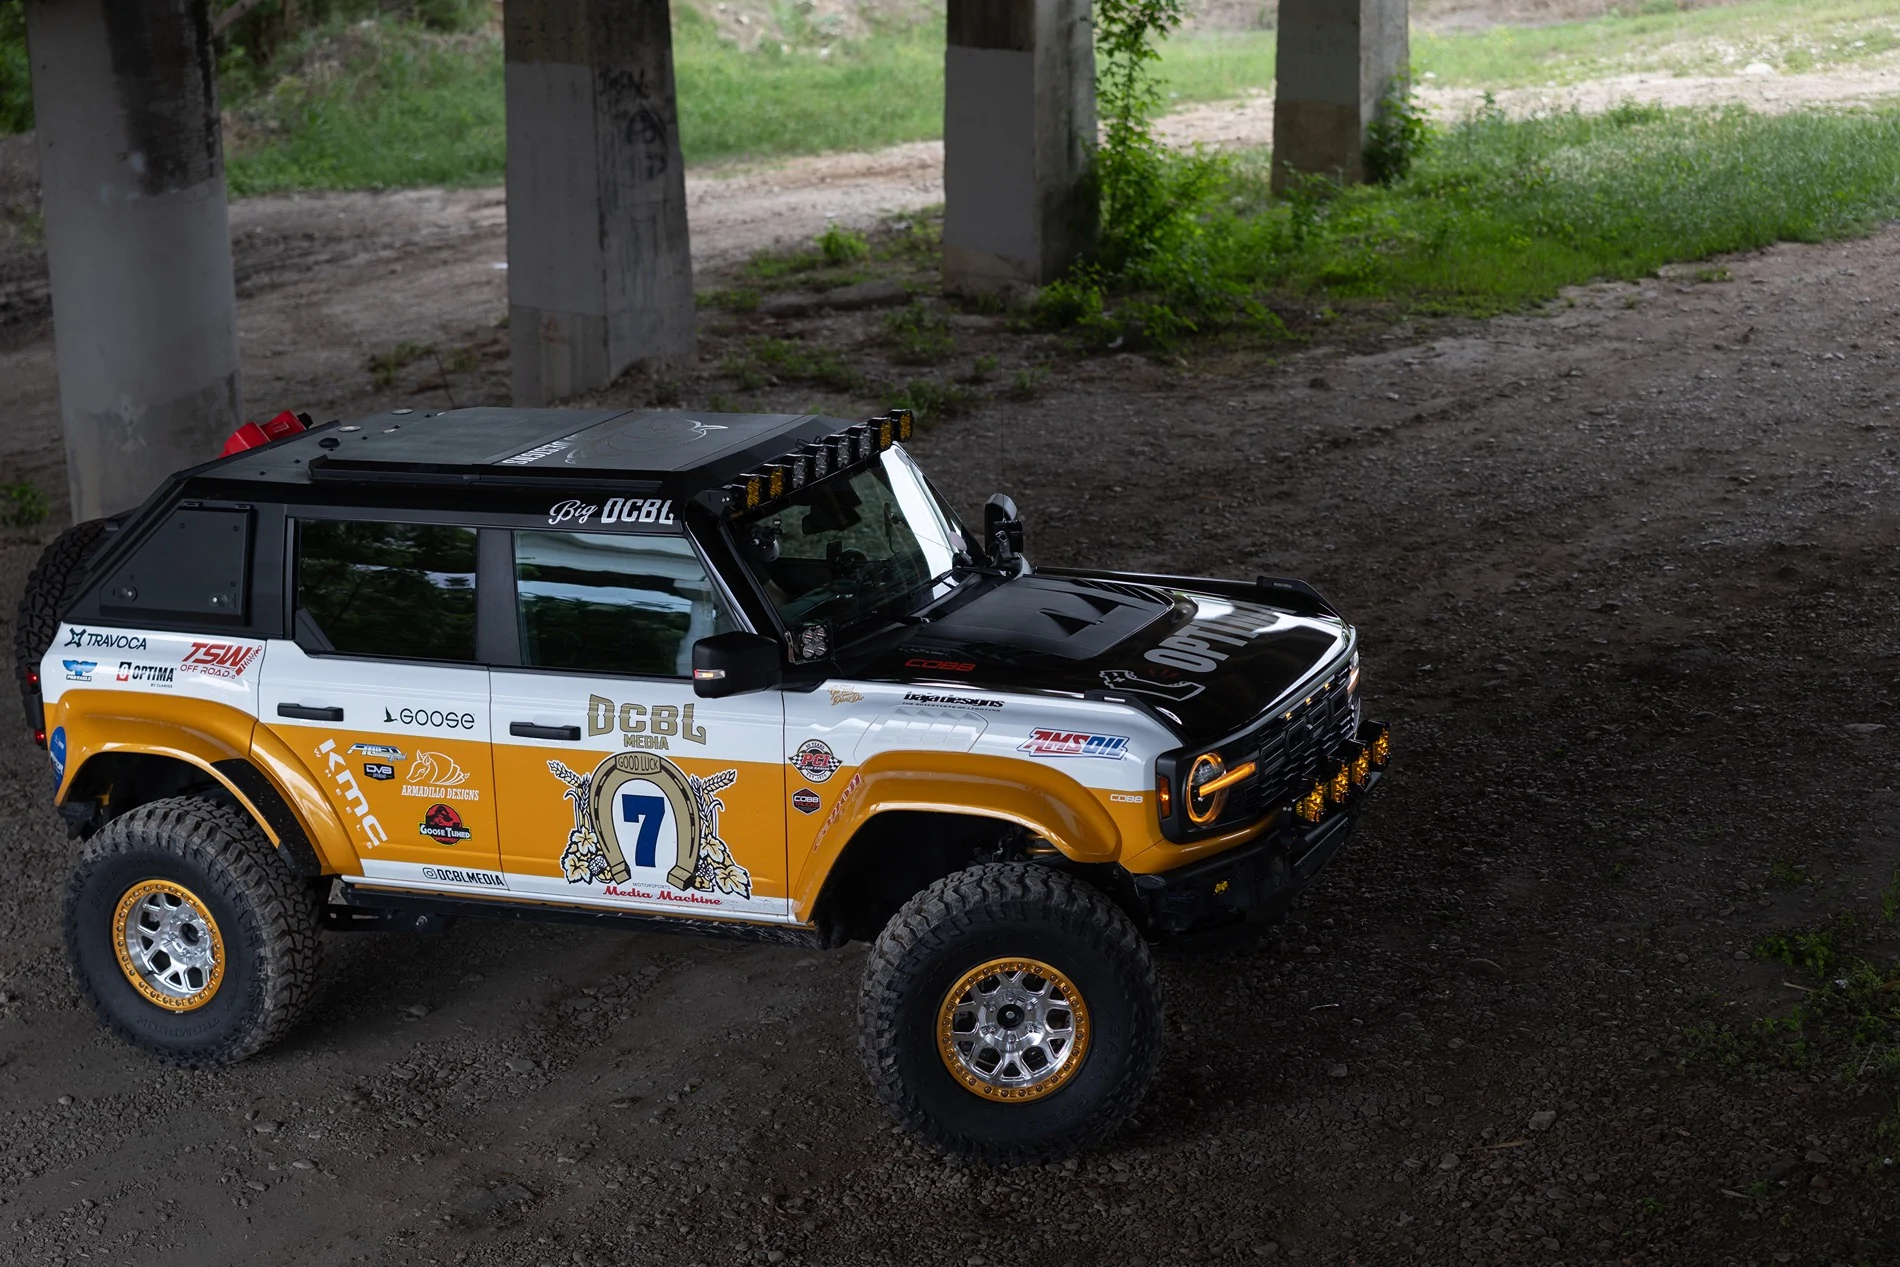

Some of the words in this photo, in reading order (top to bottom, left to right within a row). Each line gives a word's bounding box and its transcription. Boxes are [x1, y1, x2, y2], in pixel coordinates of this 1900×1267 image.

[548, 499, 599, 525] Big
[601, 498, 675, 525] DCBL
[87, 632, 147, 650] TRAVOCA
[182, 642, 253, 667] TSW
[180, 664, 199, 673] OFF
[200, 666, 230, 678] ROAD
[905, 658, 976, 672] COBB
[132, 665, 175, 682] OPTIMA
[587, 693, 707, 745] DCBL
[623, 734, 669, 750] MEDIA
[1028, 730, 1128, 759] AMSOIL
[618, 755, 640, 770] GOOD
[640, 756, 659, 771] LUCK
[801, 753, 831, 767] PCI
[366, 764, 392, 774] DV8
[401, 785, 446, 799] ARMADILLO
[446, 788, 480, 801] DESIGNS
[794, 795, 819, 803] COBB
[1110, 793, 1144, 803] COBB
[621, 793, 666, 868] 7
[633, 882, 671, 890] MOTORSPORTS
[603, 886, 654, 899] Media
[657, 890, 723, 905] Machine
